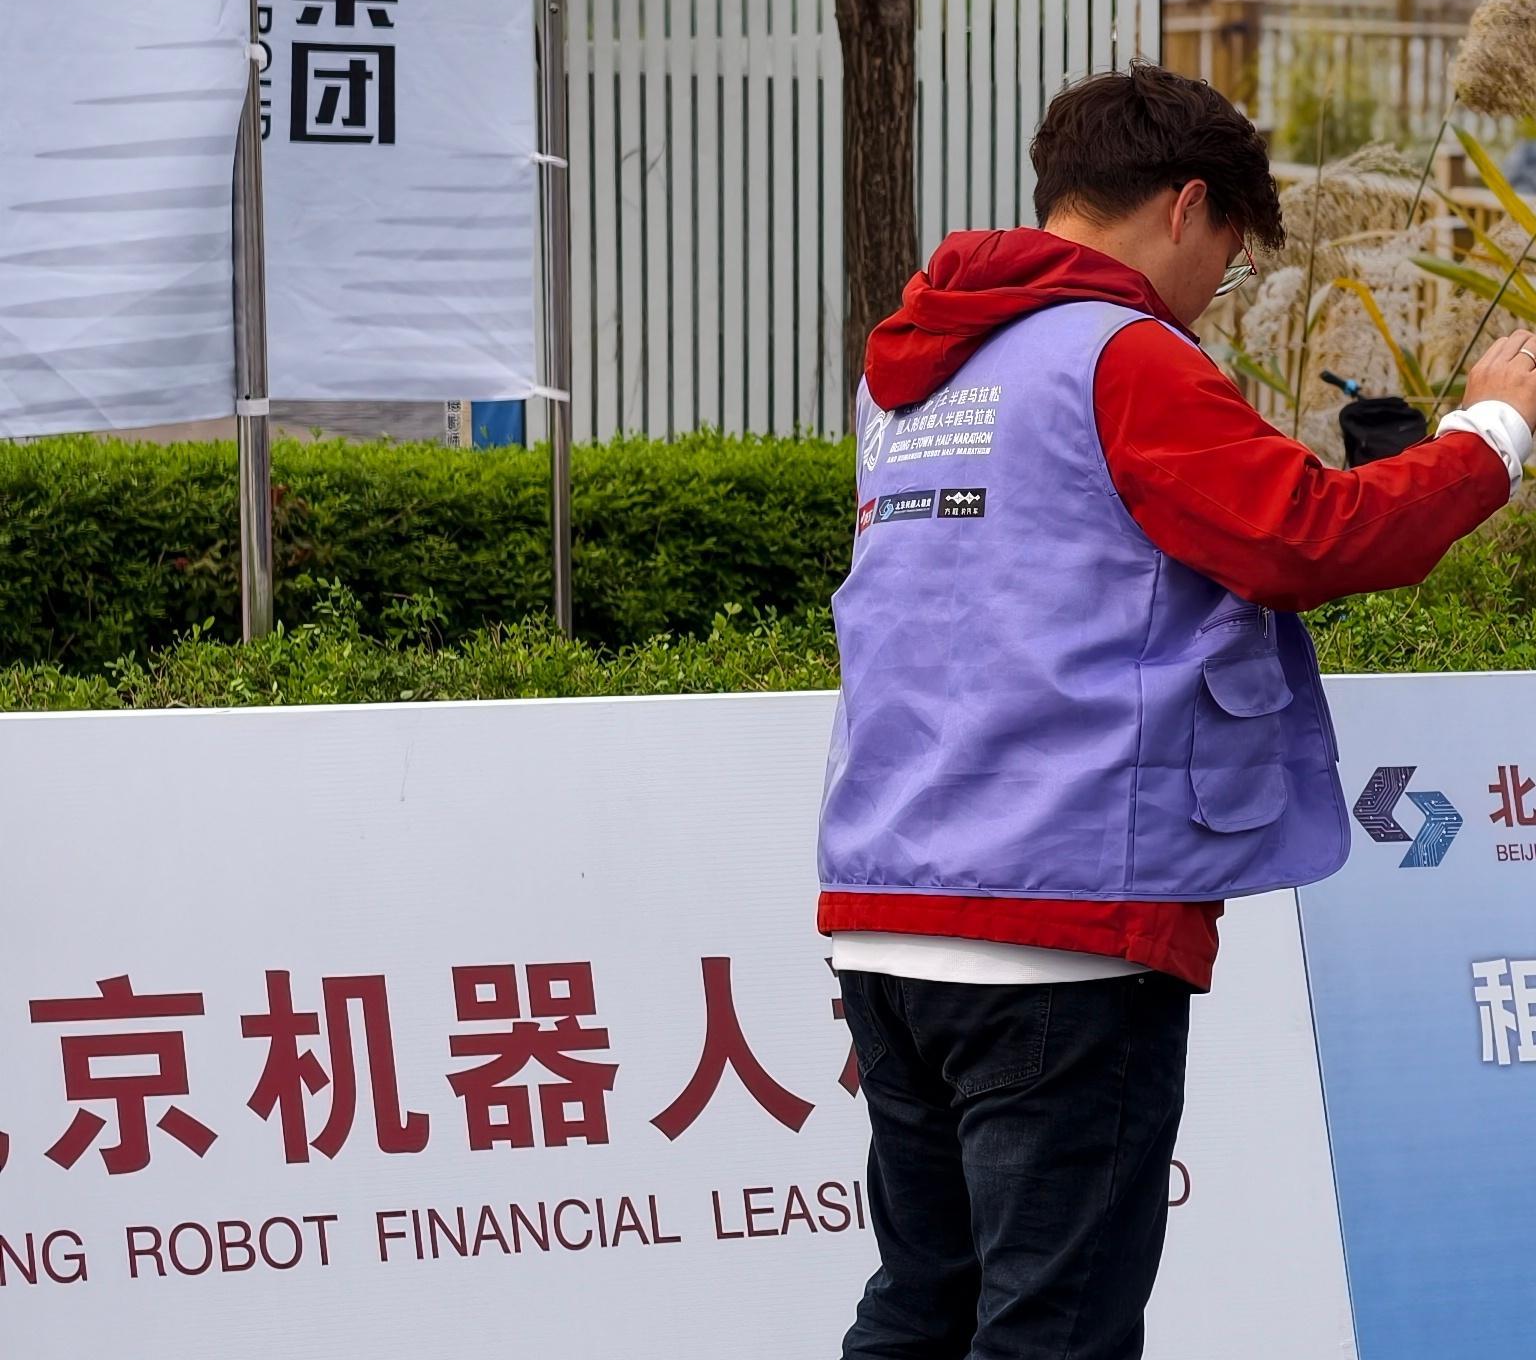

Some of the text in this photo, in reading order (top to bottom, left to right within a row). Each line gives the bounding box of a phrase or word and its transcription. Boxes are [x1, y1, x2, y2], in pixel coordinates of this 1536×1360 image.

[934, 433, 954, 447] HALF
[951, 432, 994, 445] MARATHON
[126, 1213, 339, 1279] ROBOT
[375, 1193, 682, 1263] FINANCIAL
[712, 1179, 866, 1242] LEASI
